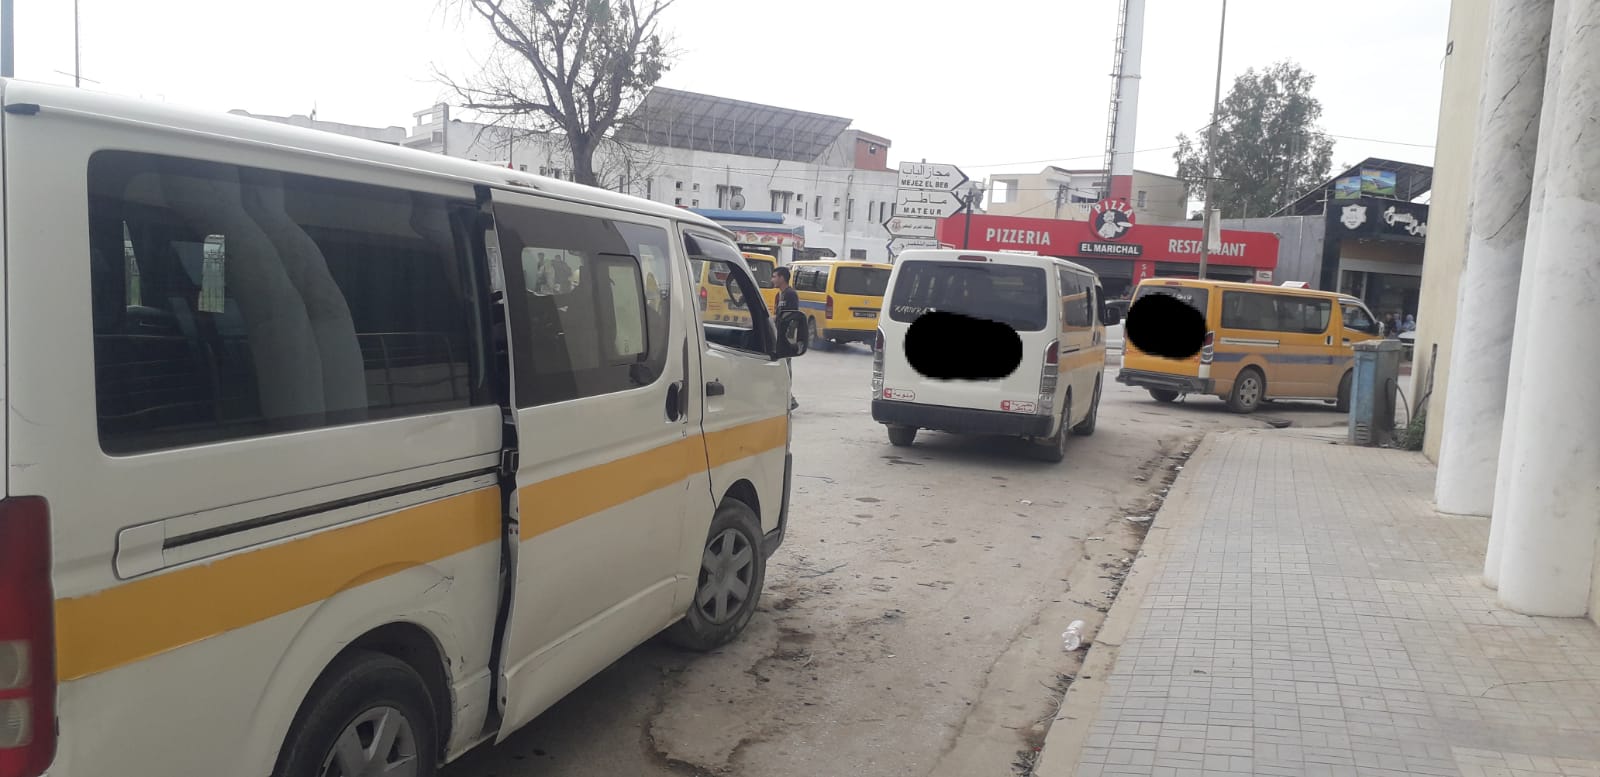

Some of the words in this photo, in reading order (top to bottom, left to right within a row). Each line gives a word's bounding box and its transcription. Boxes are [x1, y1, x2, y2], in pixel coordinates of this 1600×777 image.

[901, 179, 924, 187] MEJEZ
[935, 181, 949, 189] BEB
[899, 191, 948, 206] ماطر
[903, 207, 942, 216] MATEUR
[1094, 199, 1133, 218] PIZZA
[986, 227, 1051, 246] PIZZERIA
[1081, 243, 1093, 252] EL
[1093, 243, 1140, 255] MARICHAL
[1168, 238, 1247, 257] RESTARANT
